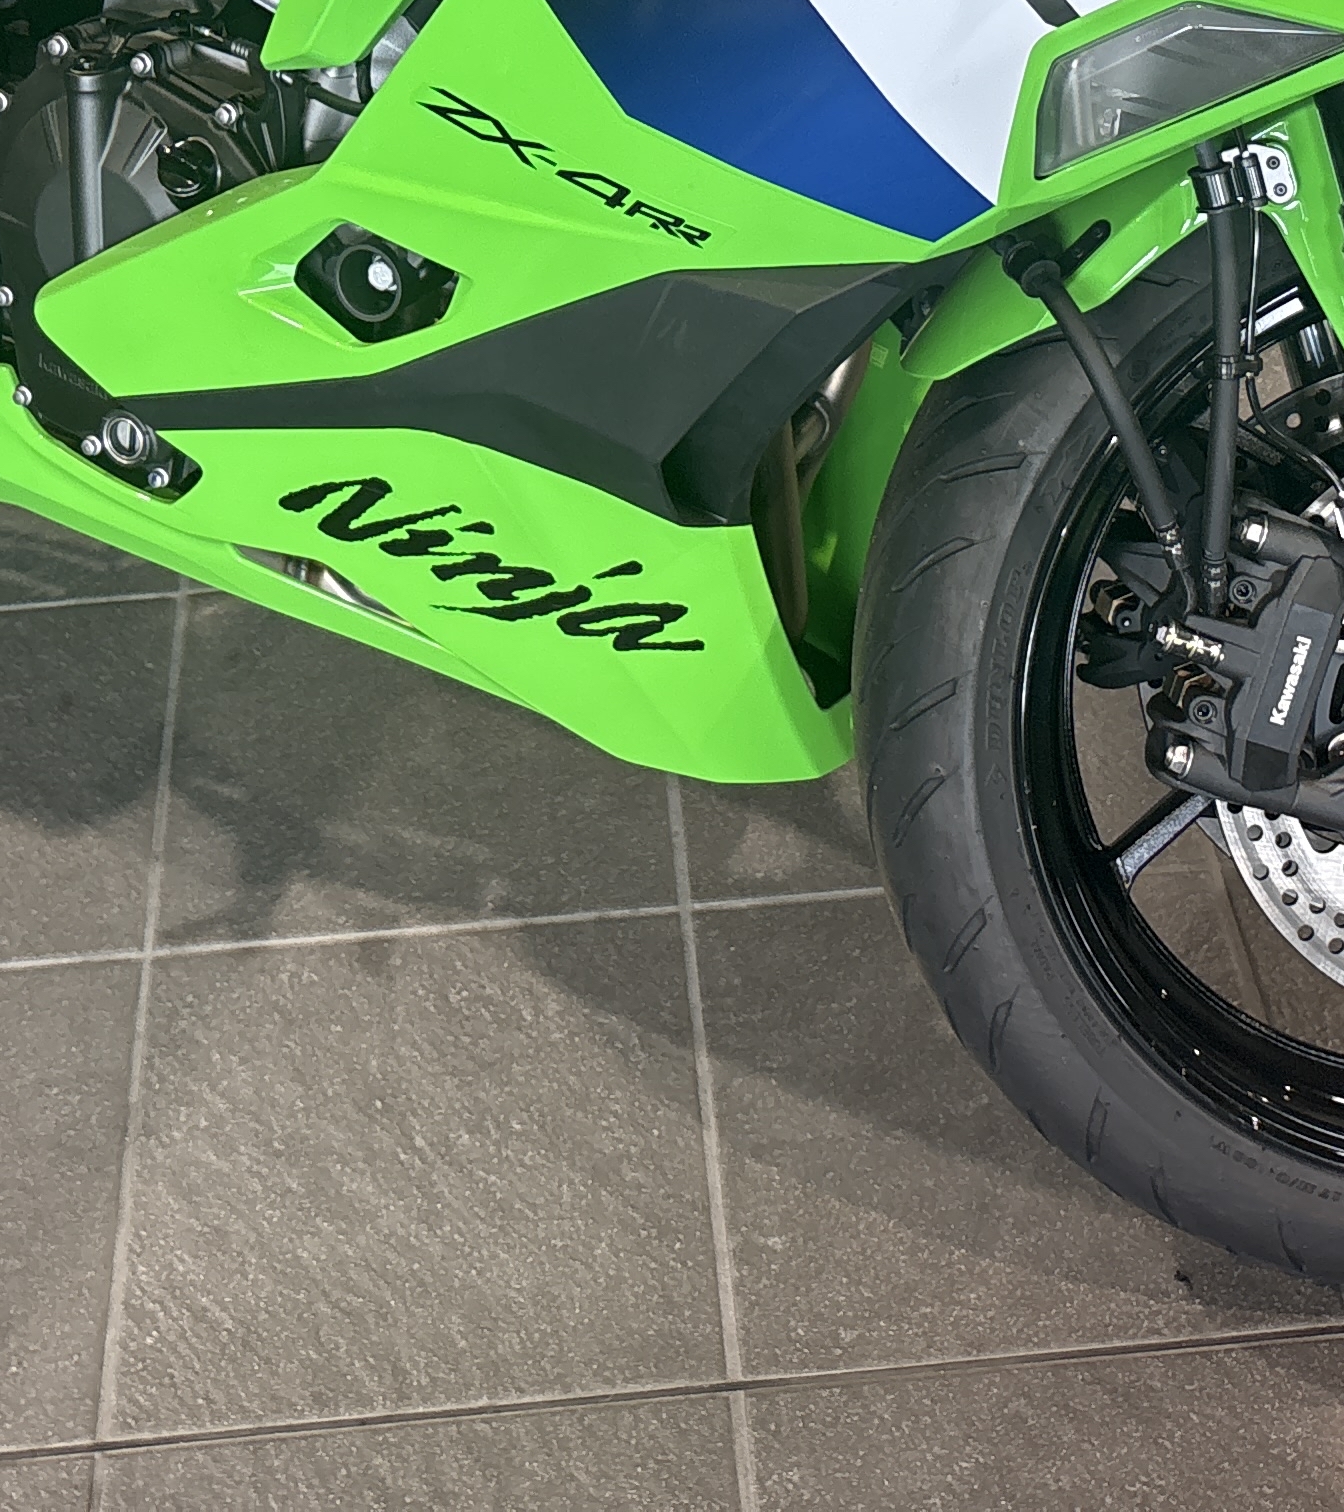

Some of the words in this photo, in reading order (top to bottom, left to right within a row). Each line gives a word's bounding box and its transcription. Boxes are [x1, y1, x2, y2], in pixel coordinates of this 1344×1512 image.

[417, 86, 711, 248] ZX-4RR
[277, 475, 706, 652] Ninja
[1269, 635, 1312, 726] Kawasaki
